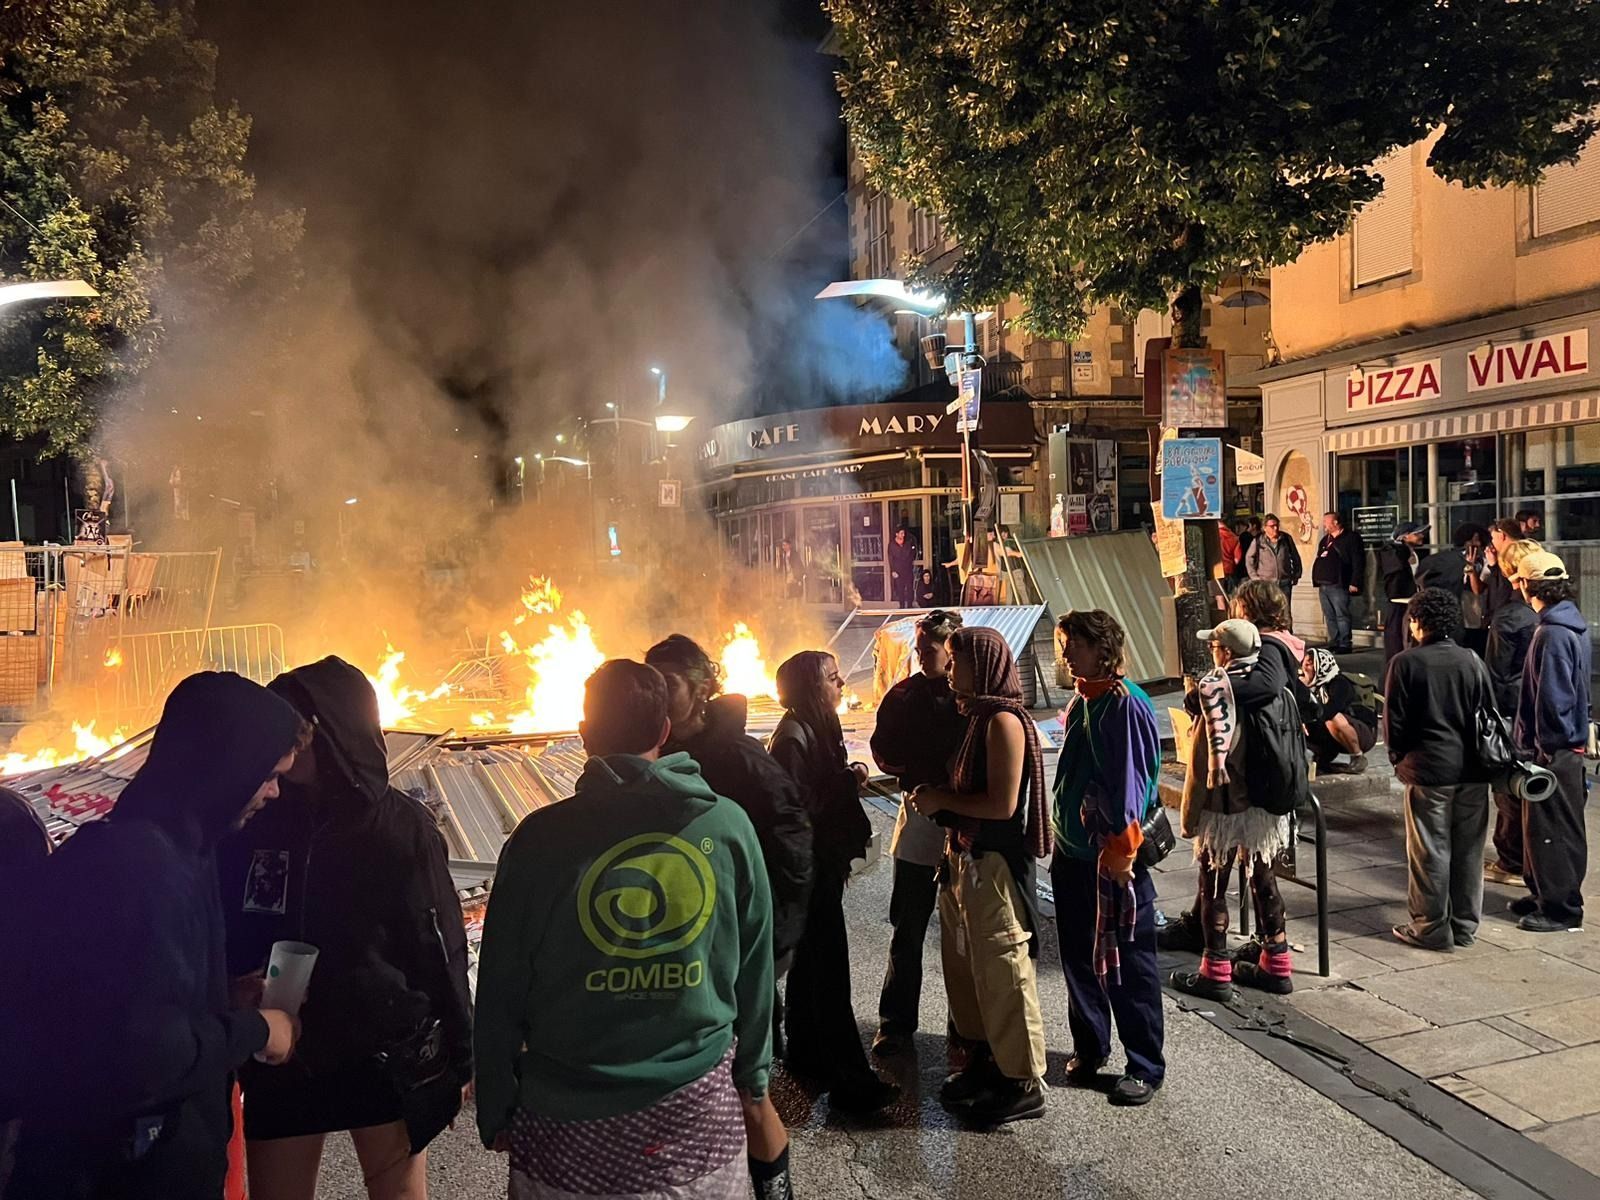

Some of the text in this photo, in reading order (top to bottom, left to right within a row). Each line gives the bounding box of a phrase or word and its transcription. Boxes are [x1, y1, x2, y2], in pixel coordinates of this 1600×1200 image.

[1469, 335, 1588, 387] VIVAL
[1347, 363, 1441, 409] PIZZA
[747, 424, 800, 449] CAFE
[859, 414, 944, 436] MARY
[833, 464, 865, 474] MARY
[585, 960, 703, 992] COMBO
